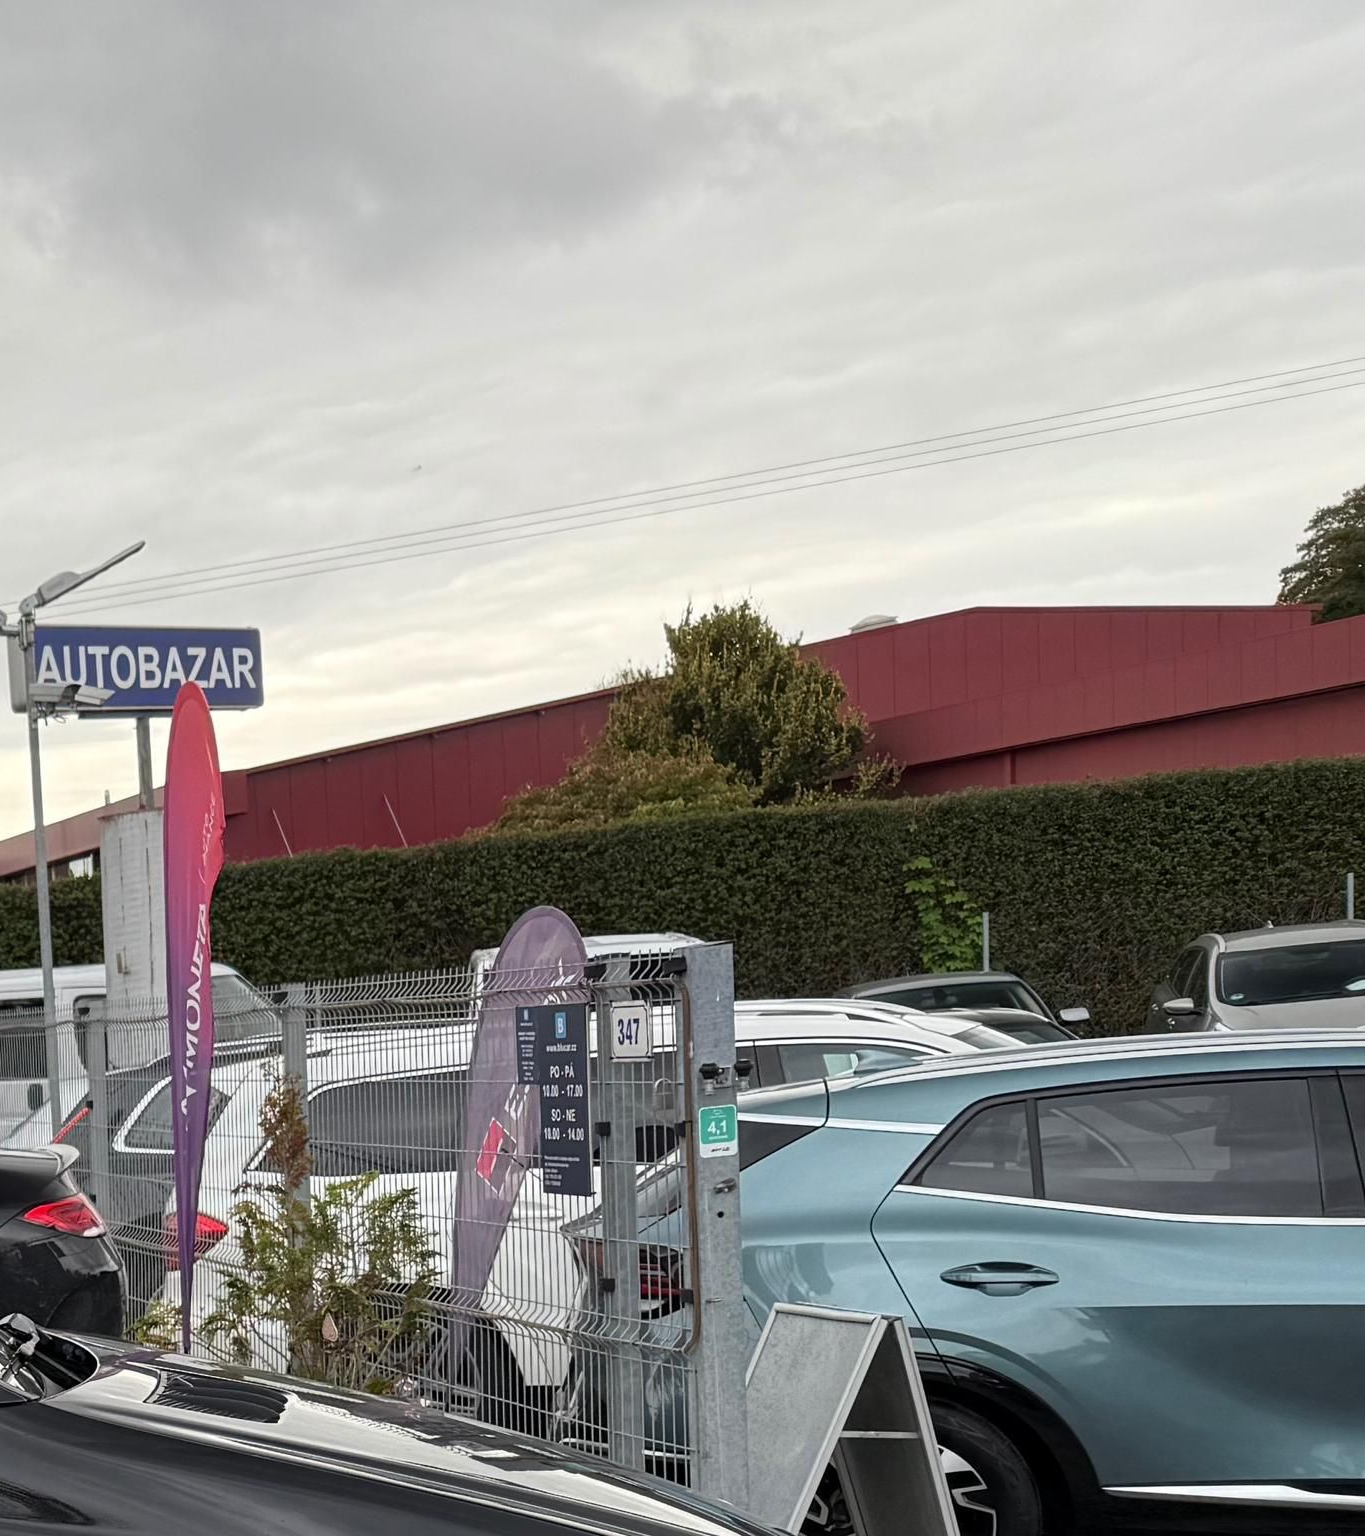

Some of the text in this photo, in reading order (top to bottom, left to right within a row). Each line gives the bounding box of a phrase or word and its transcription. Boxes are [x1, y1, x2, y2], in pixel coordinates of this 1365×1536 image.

[38, 645, 256, 689] AUTOBAZAR
[617, 1018, 640, 1046] 347
[707, 1119, 728, 1135] 4,1
